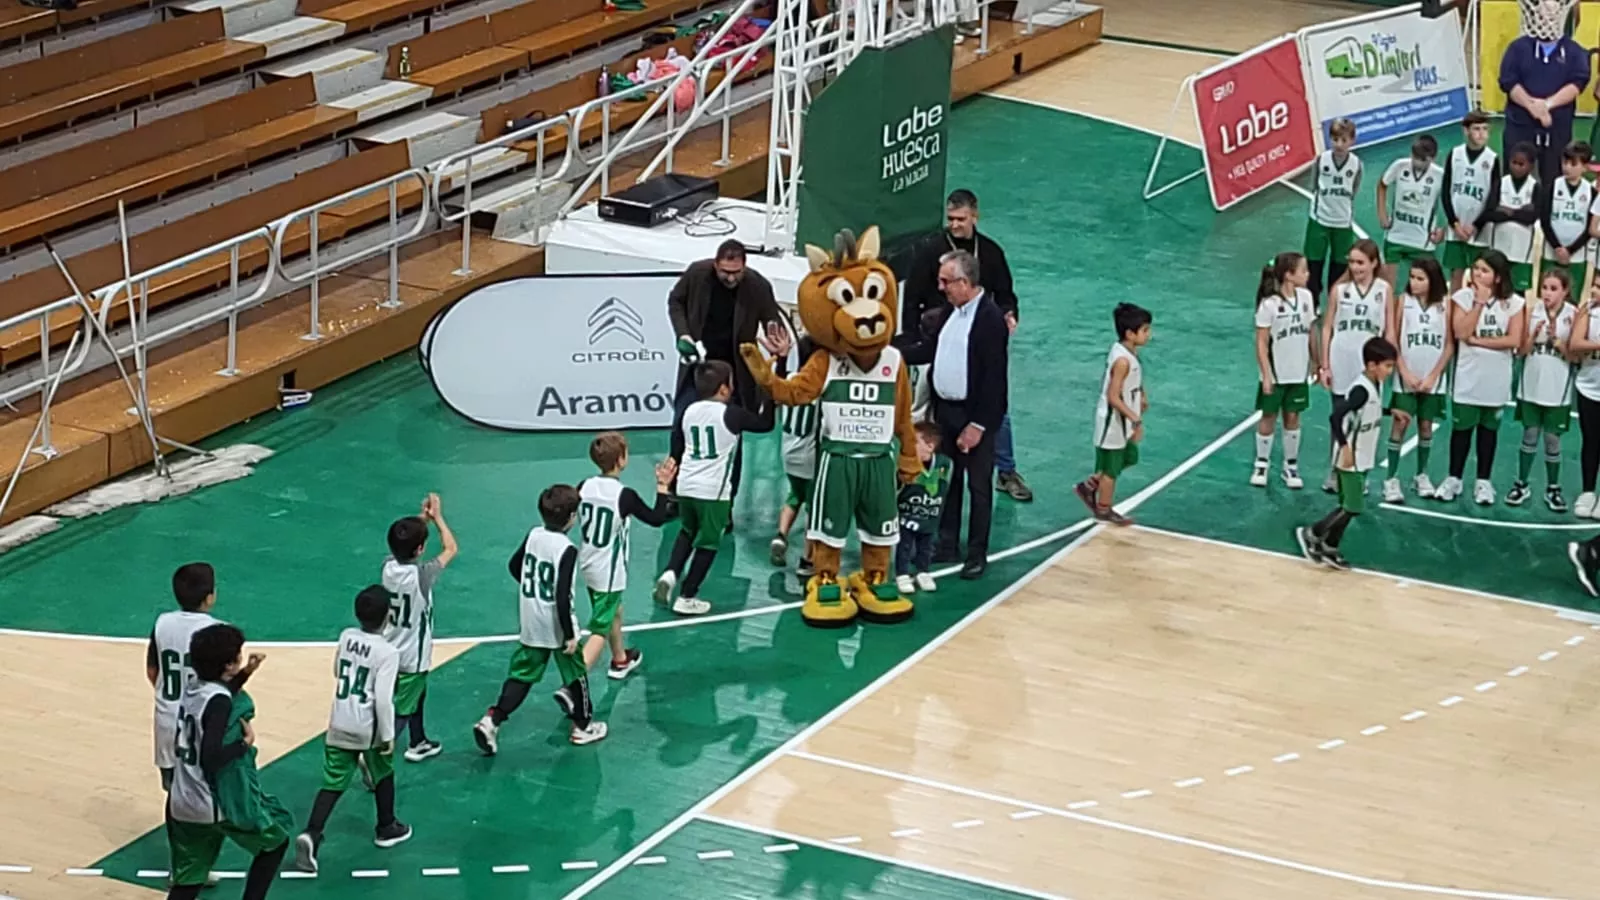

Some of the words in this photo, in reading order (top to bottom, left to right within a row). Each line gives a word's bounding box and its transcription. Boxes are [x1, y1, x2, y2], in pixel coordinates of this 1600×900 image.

[883, 104, 943, 147] Lobe
[1220, 102, 1289, 154] Lobe
[881, 132, 940, 179] Huesca
[1407, 331, 1443, 350] PEÑAS
[839, 406, 886, 420] Lobe
[849, 382, 879, 402] 00
[689, 425, 718, 460] 11
[580, 502, 614, 548] 20
[522, 553, 555, 602] 38
[346, 638, 371, 659] IAN
[336, 658, 370, 704] 54
